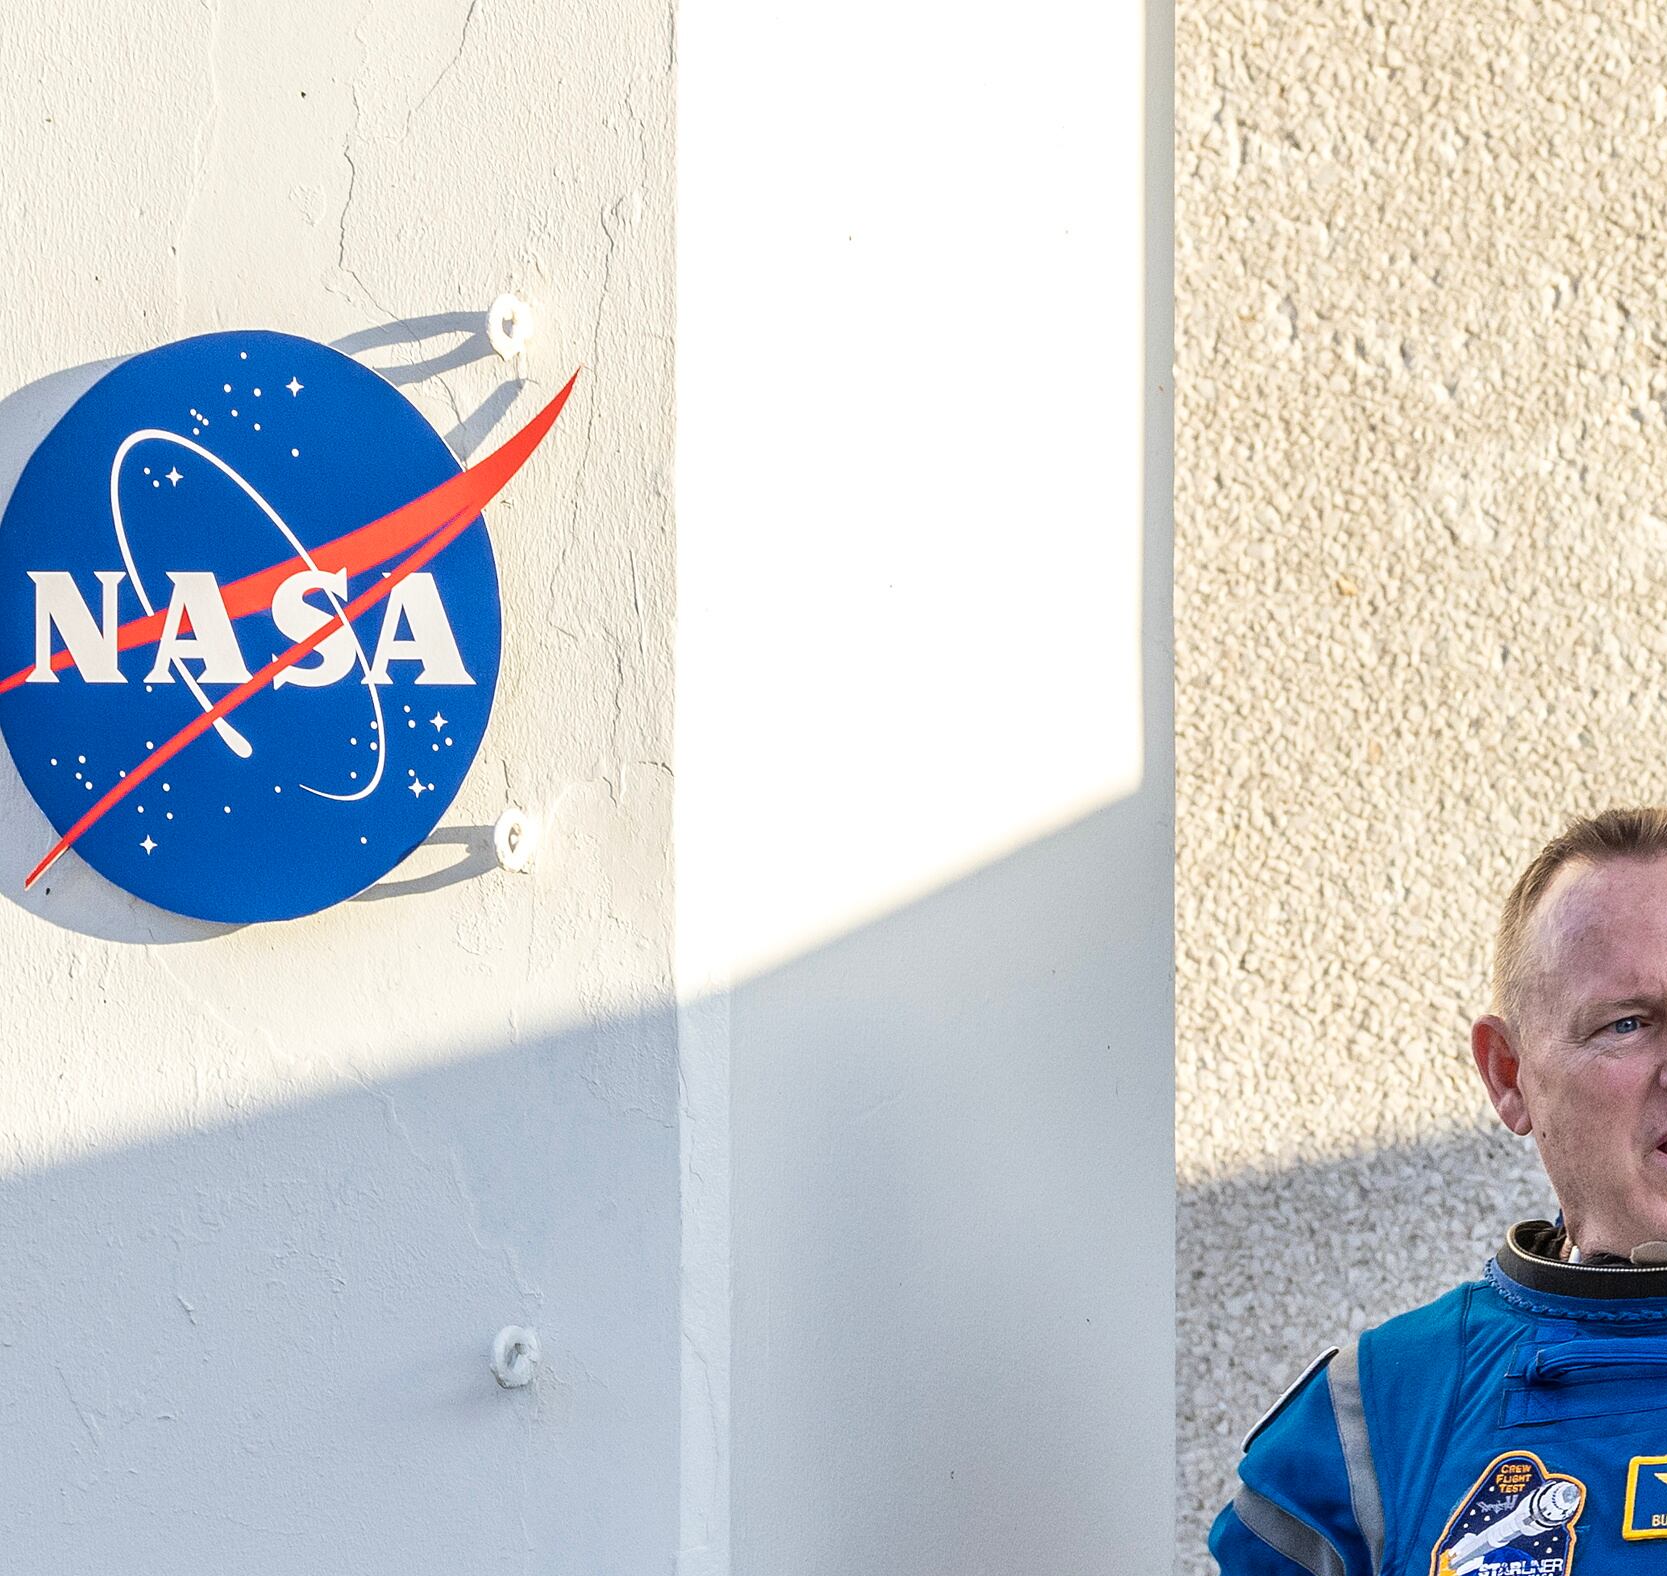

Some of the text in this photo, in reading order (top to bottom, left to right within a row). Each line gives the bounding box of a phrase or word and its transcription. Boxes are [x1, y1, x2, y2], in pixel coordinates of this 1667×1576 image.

[25, 566, 477, 690] NASA
[1501, 1464, 1532, 1474] CREW
[1495, 1474, 1533, 1485] FLIGHT
[1499, 1483, 1526, 1494] TEST
